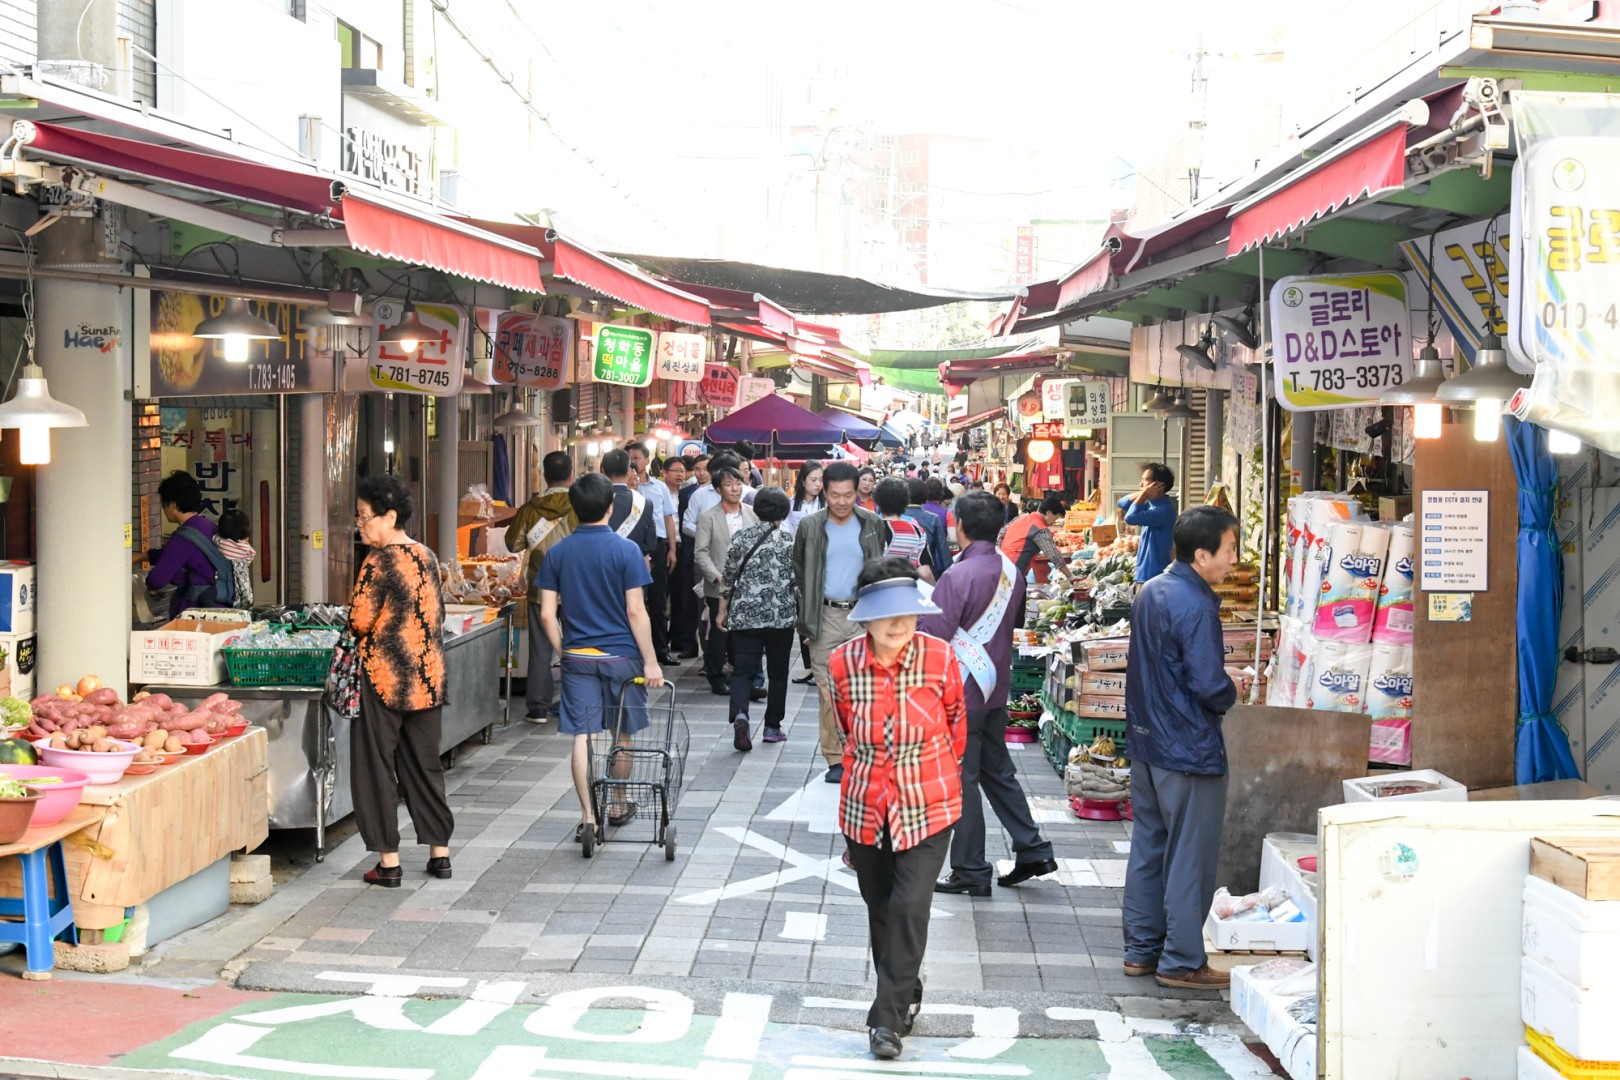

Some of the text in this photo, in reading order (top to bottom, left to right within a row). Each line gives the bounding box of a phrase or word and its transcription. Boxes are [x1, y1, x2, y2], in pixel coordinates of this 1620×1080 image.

[1309, 287, 1371, 327] 글로리
[603, 338, 645, 357] 청학동
[663, 340, 701, 359] 건어물
[1285, 322, 1402, 363] D&D스토아
[248, 363, 296, 391] T.783-1405
[389, 366, 450, 387] 781-8745
[508, 362, 559, 379] 975-8288
[601, 368, 641, 384] 781-3007
[661, 359, 699, 375] 세진상회
[1310, 363, 1403, 391] 783-3373
[1076, 417, 1107, 426] 783-5648
[172, 428, 253, 450] 장독대
[1445, 496, 1458, 504] CCTV
[1459, 496, 1470, 504] 설치
[1471, 496, 1483, 504] 안내
[1340, 553, 1381, 577] 스마일
[1319, 671, 1360, 692] 스마일
[1374, 674, 1412, 695] 스마일
